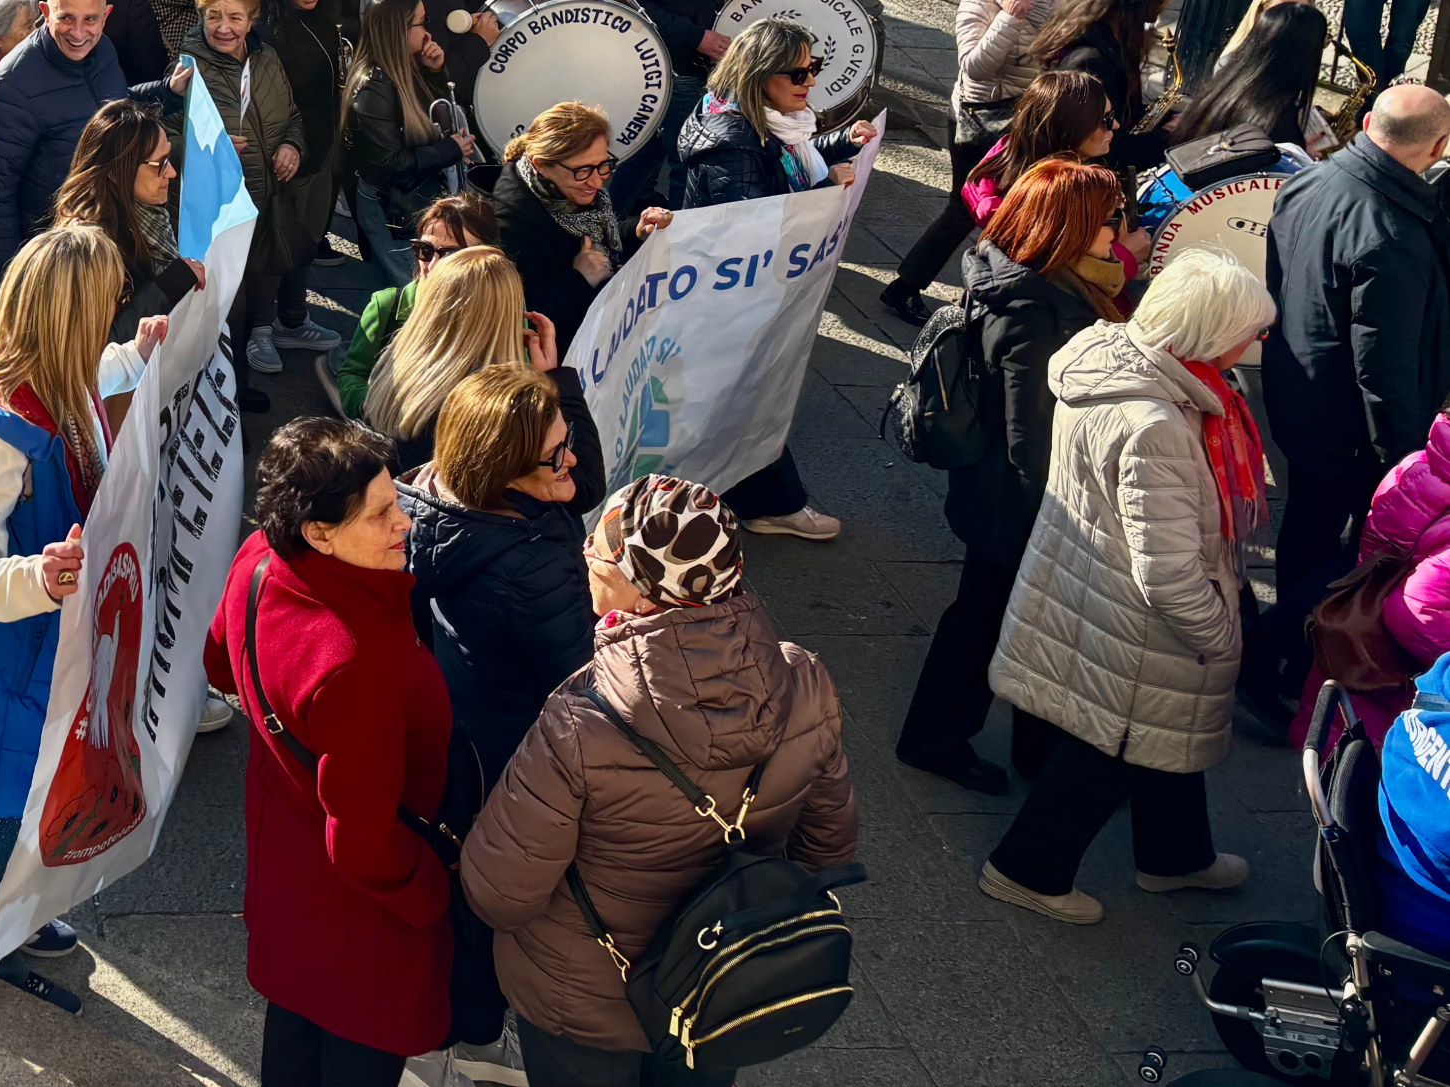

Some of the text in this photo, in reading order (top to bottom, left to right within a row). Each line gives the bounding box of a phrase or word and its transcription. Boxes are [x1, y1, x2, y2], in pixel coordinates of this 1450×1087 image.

[488, 7, 662, 146] CORPO BANDISTICO LUIGI CANEPA
[1150, 221, 1183, 276] BANDA
[591, 264, 698, 387] LAUDATO
